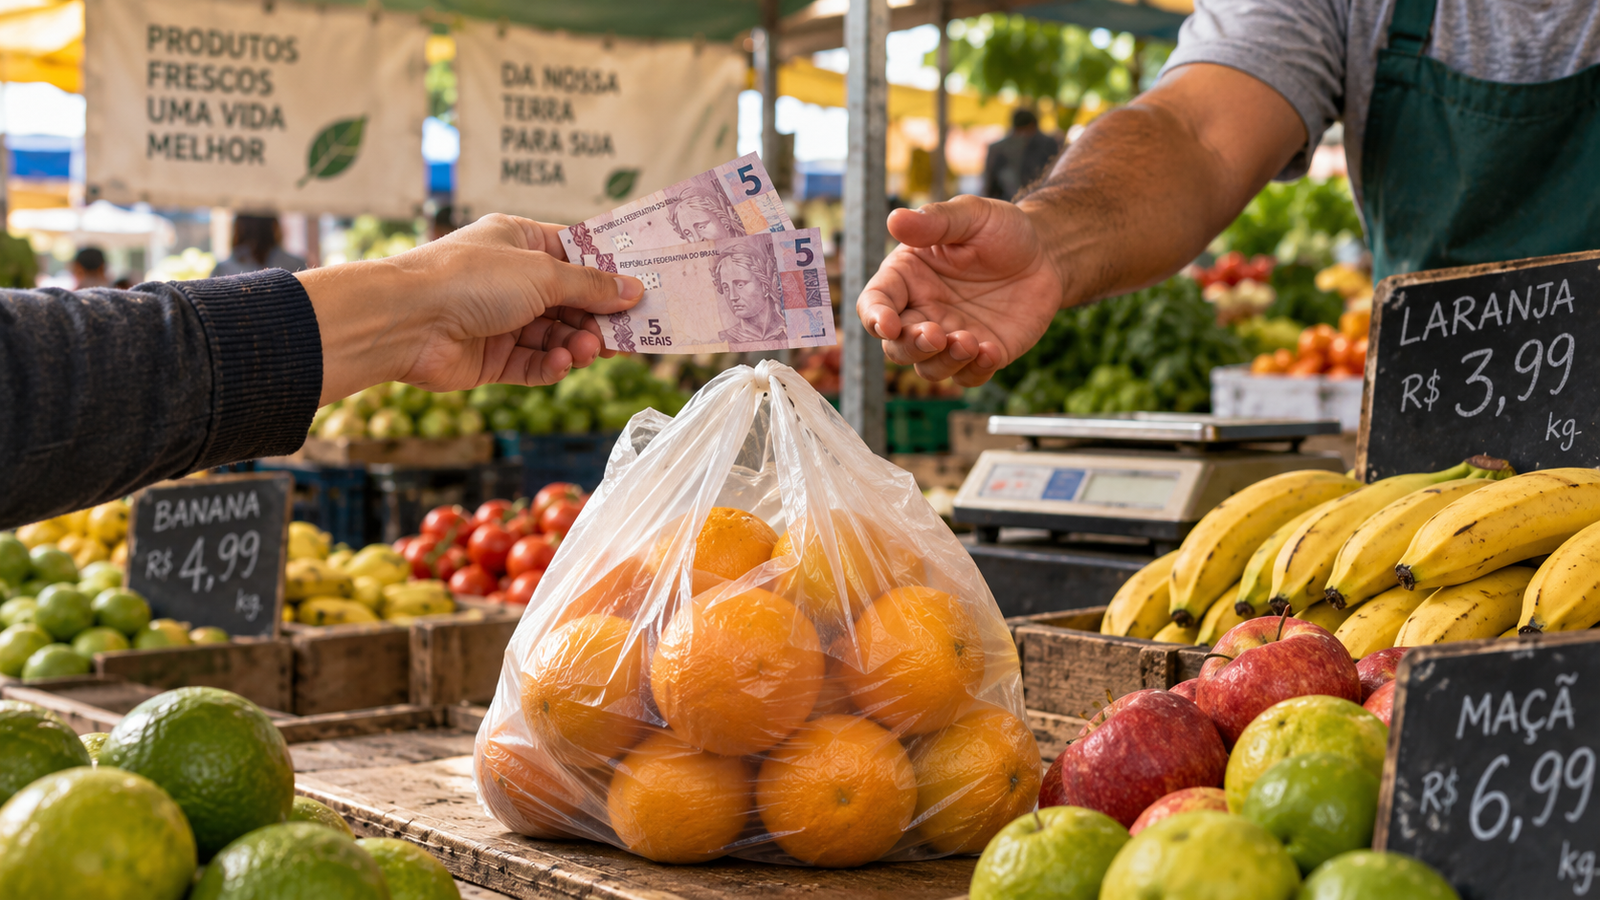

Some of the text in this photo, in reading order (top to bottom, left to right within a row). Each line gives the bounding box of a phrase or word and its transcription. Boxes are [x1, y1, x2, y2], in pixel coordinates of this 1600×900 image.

[147, 24, 299, 64] PRODUTOS
[147, 61, 274, 96] FRESCOS
[501, 63, 620, 94] DA NOSSA
[147, 97, 286, 131] UMA VIDA
[501, 95, 575, 123] TERRA
[147, 133, 266, 165] MELHOR
[501, 127, 615, 157] PARA SUA
[501, 159, 566, 186] MESA
[737, 164, 762, 196] 5
[689, 252, 699, 260] DO
[795, 237, 814, 267] 5
[648, 318, 662, 335] 5
[1400, 278, 1575, 346] LARANJA
[640, 336, 672, 347] REAIS
[1401, 333, 1576, 418] R$ 3,99
[153, 489, 260, 533] BANANA
[145, 529, 261, 593] R$ 4,99
[1455, 672, 1579, 745] MAÇÃ
[1420, 746, 1597, 843] R$ 6,99
